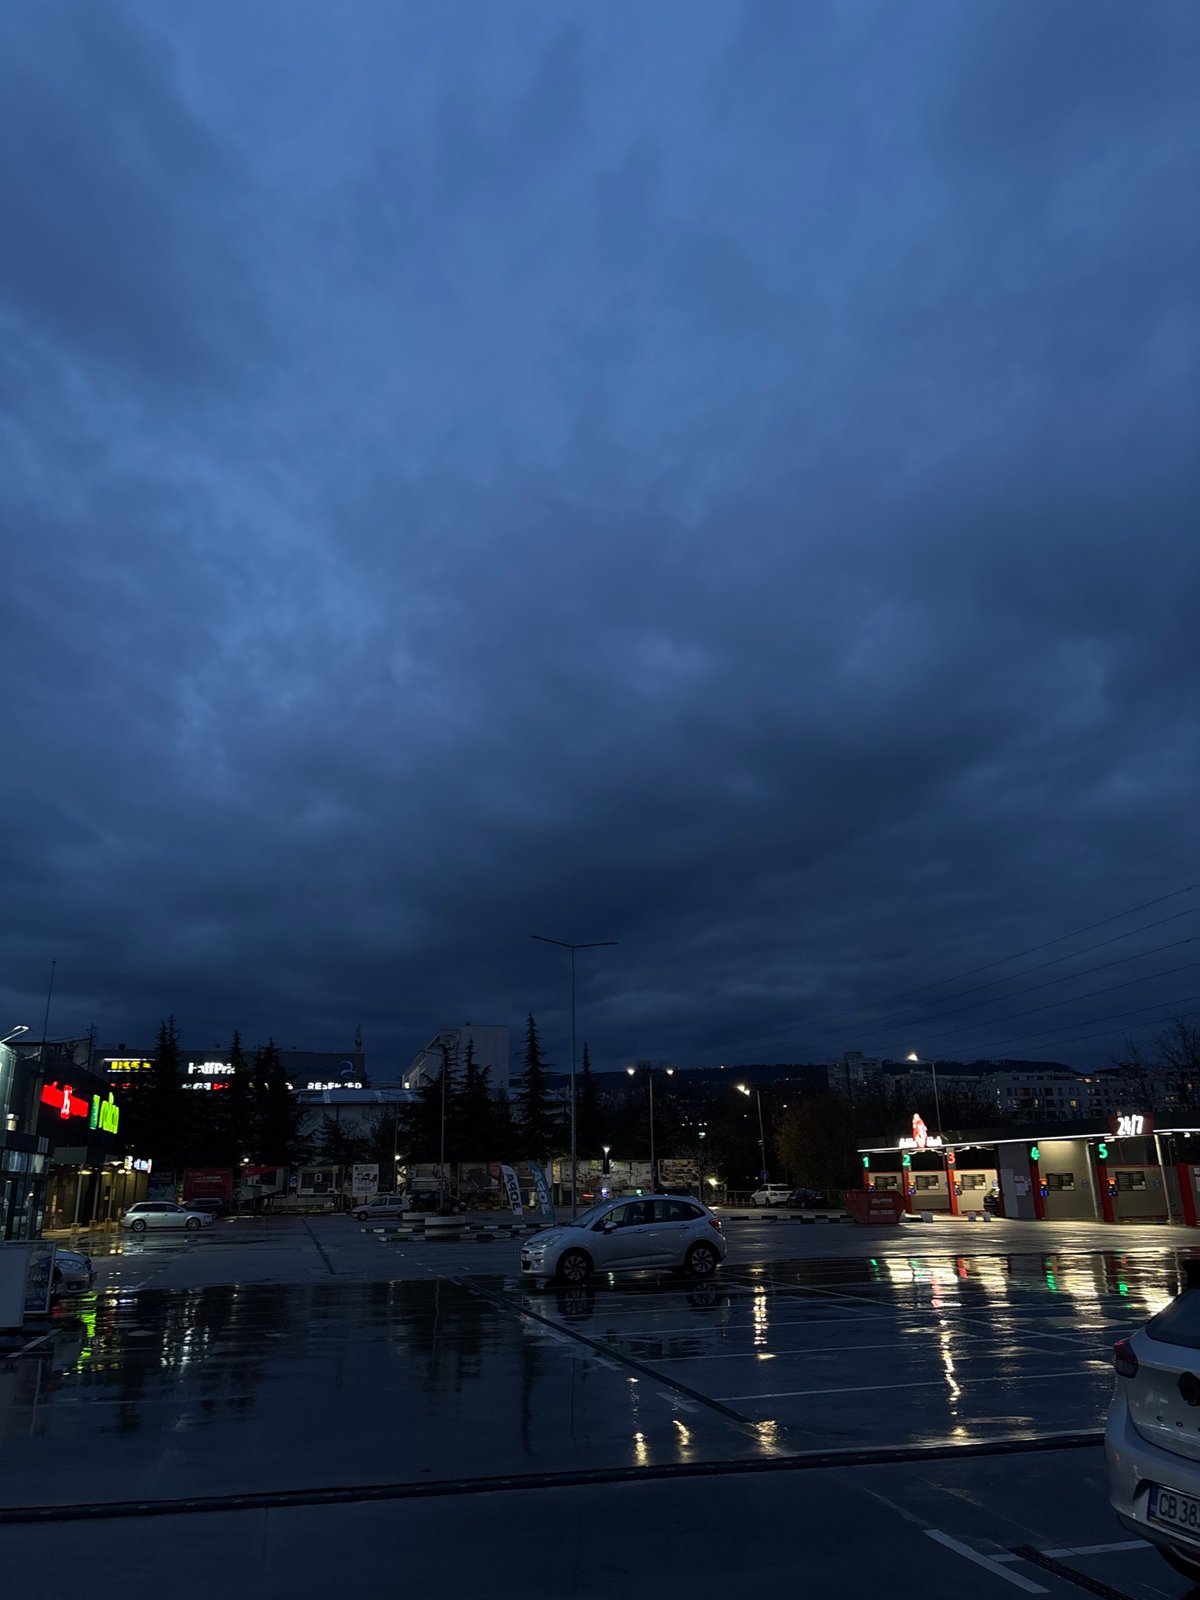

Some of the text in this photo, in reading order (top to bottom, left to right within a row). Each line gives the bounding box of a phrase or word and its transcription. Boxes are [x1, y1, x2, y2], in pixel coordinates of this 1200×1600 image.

[1117, 1114, 1144, 1136] 24/7
[1031, 1147, 1039, 1160] 4
[1098, 1143, 1108, 1159] 5
[862, 1157, 870, 1168] 1
[902, 1154, 911, 1167] 2
[948, 1152, 956, 1165] 3
[1159, 1493, 1200, 1529] CB 38
